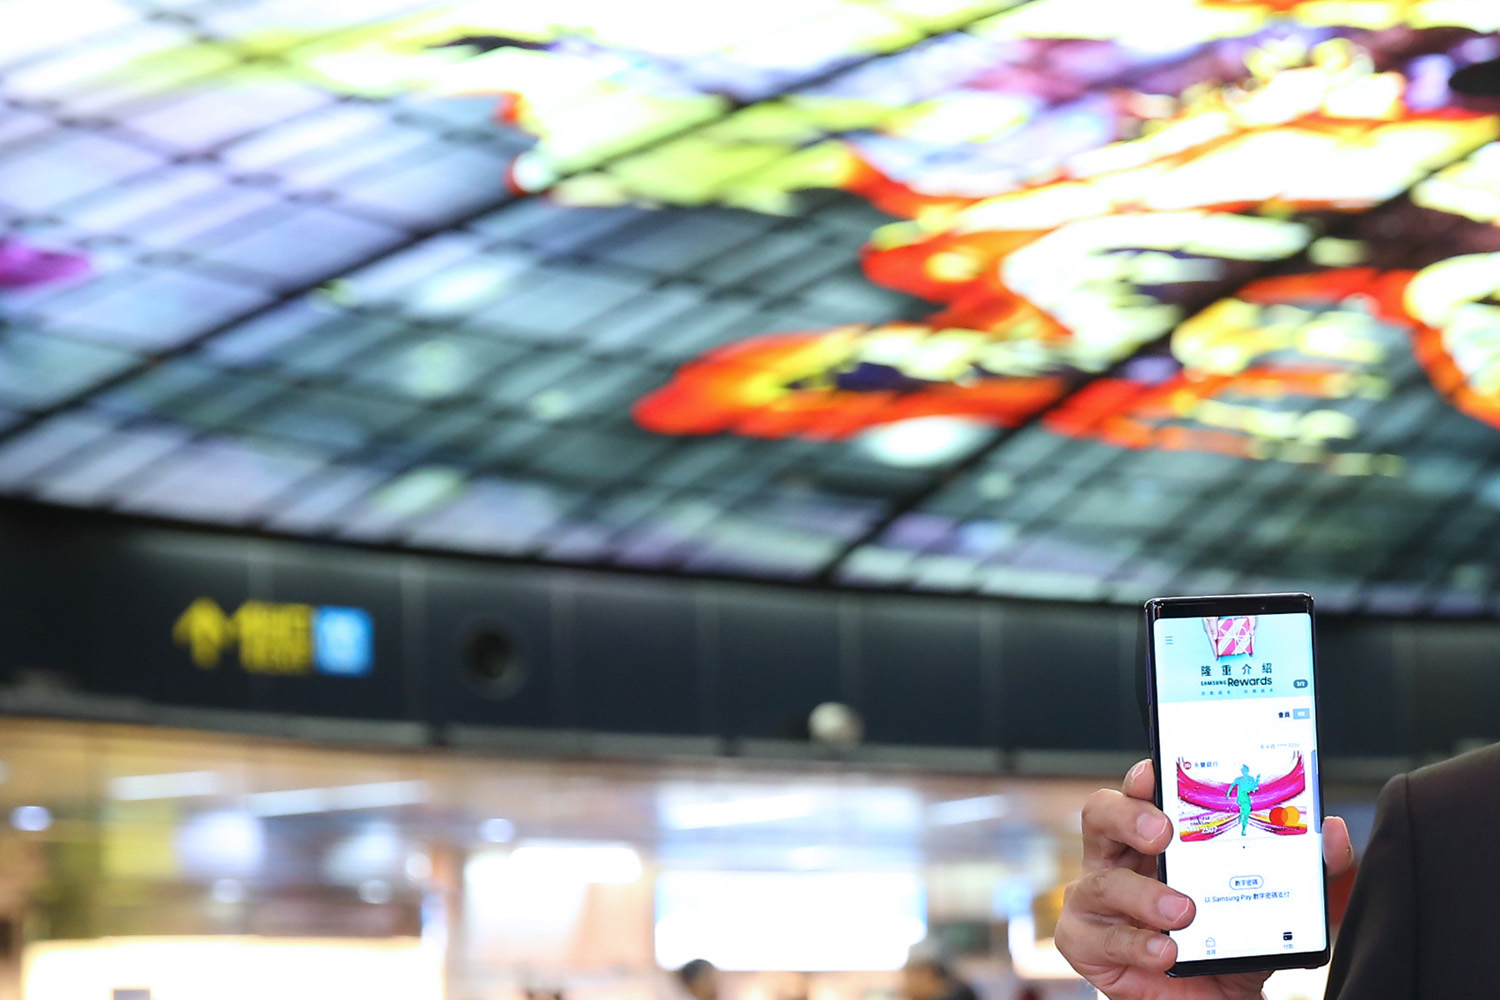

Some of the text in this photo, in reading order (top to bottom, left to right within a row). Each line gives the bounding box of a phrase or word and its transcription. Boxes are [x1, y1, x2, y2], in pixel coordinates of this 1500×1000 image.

[1201, 663, 1272, 676] 隆重介紹
[1227, 676, 1273, 687] Rewards
[1212, 894, 1240, 902] Samsung
[1240, 893, 1252, 901] Pay
